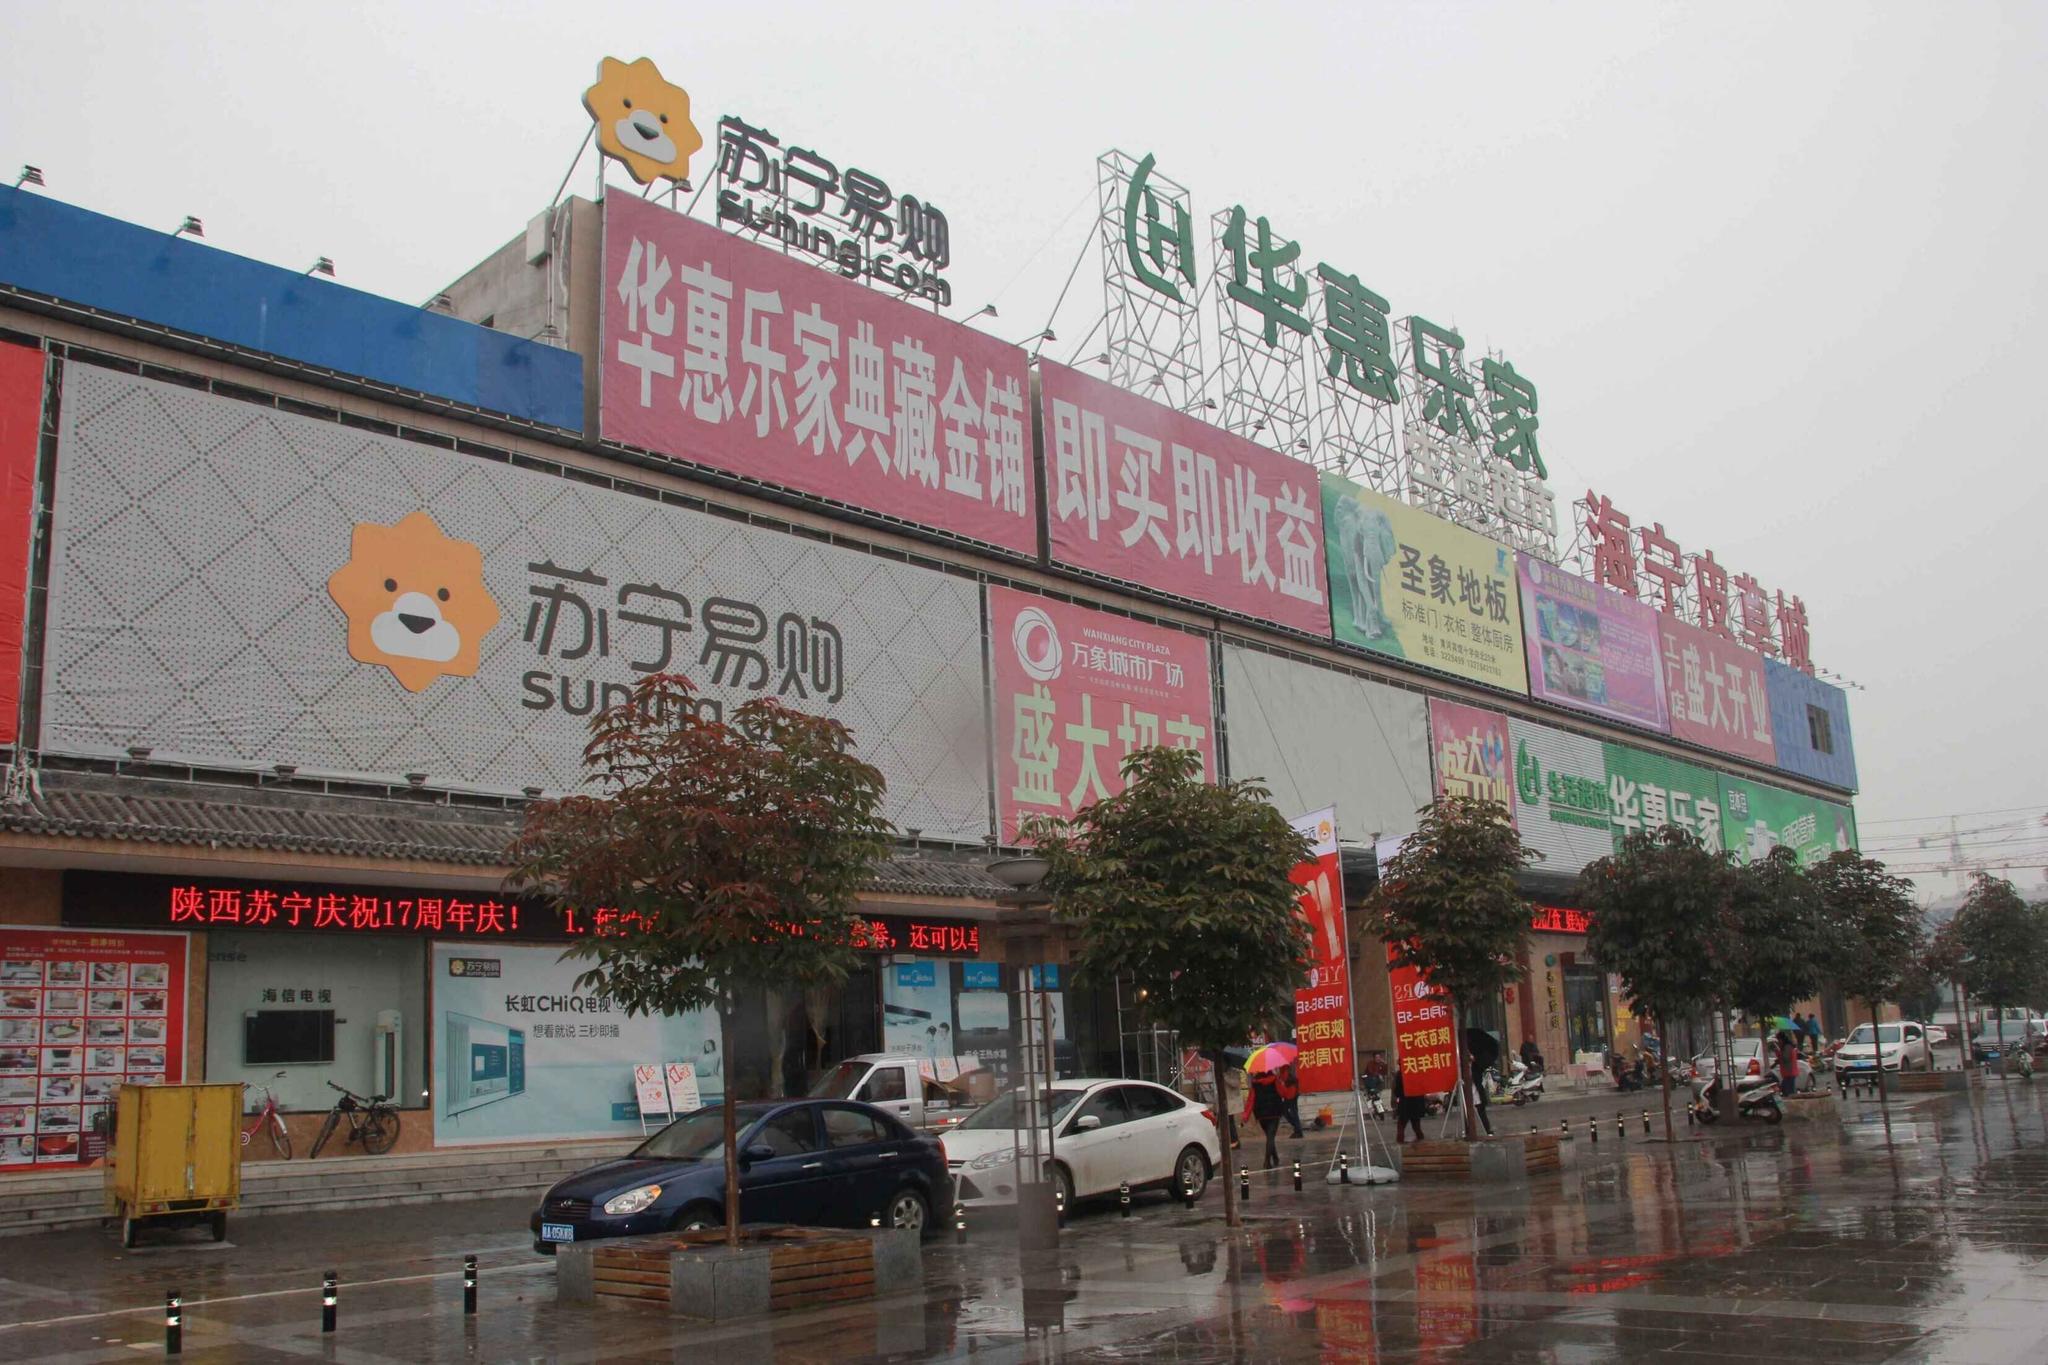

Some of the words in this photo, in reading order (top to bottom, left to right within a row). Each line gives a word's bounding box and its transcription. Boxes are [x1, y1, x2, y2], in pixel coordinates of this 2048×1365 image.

[717, 114, 950, 270] 苏宁易购
[616, 235, 1027, 518] 华惠乐家典藏金铺
[1222, 203, 1549, 480] 华惠乐家
[1052, 398, 1323, 605] 即买即收益
[523, 558, 844, 703] 苏宁易购
[1398, 543, 1510, 626] 圣象地板
[1585, 488, 1816, 680] 海宁皮革城
[1071, 641, 1185, 689] 万象城市广场
[1681, 643, 1773, 745] 盛大开业
[261, 988, 332, 1004] 海信电视
